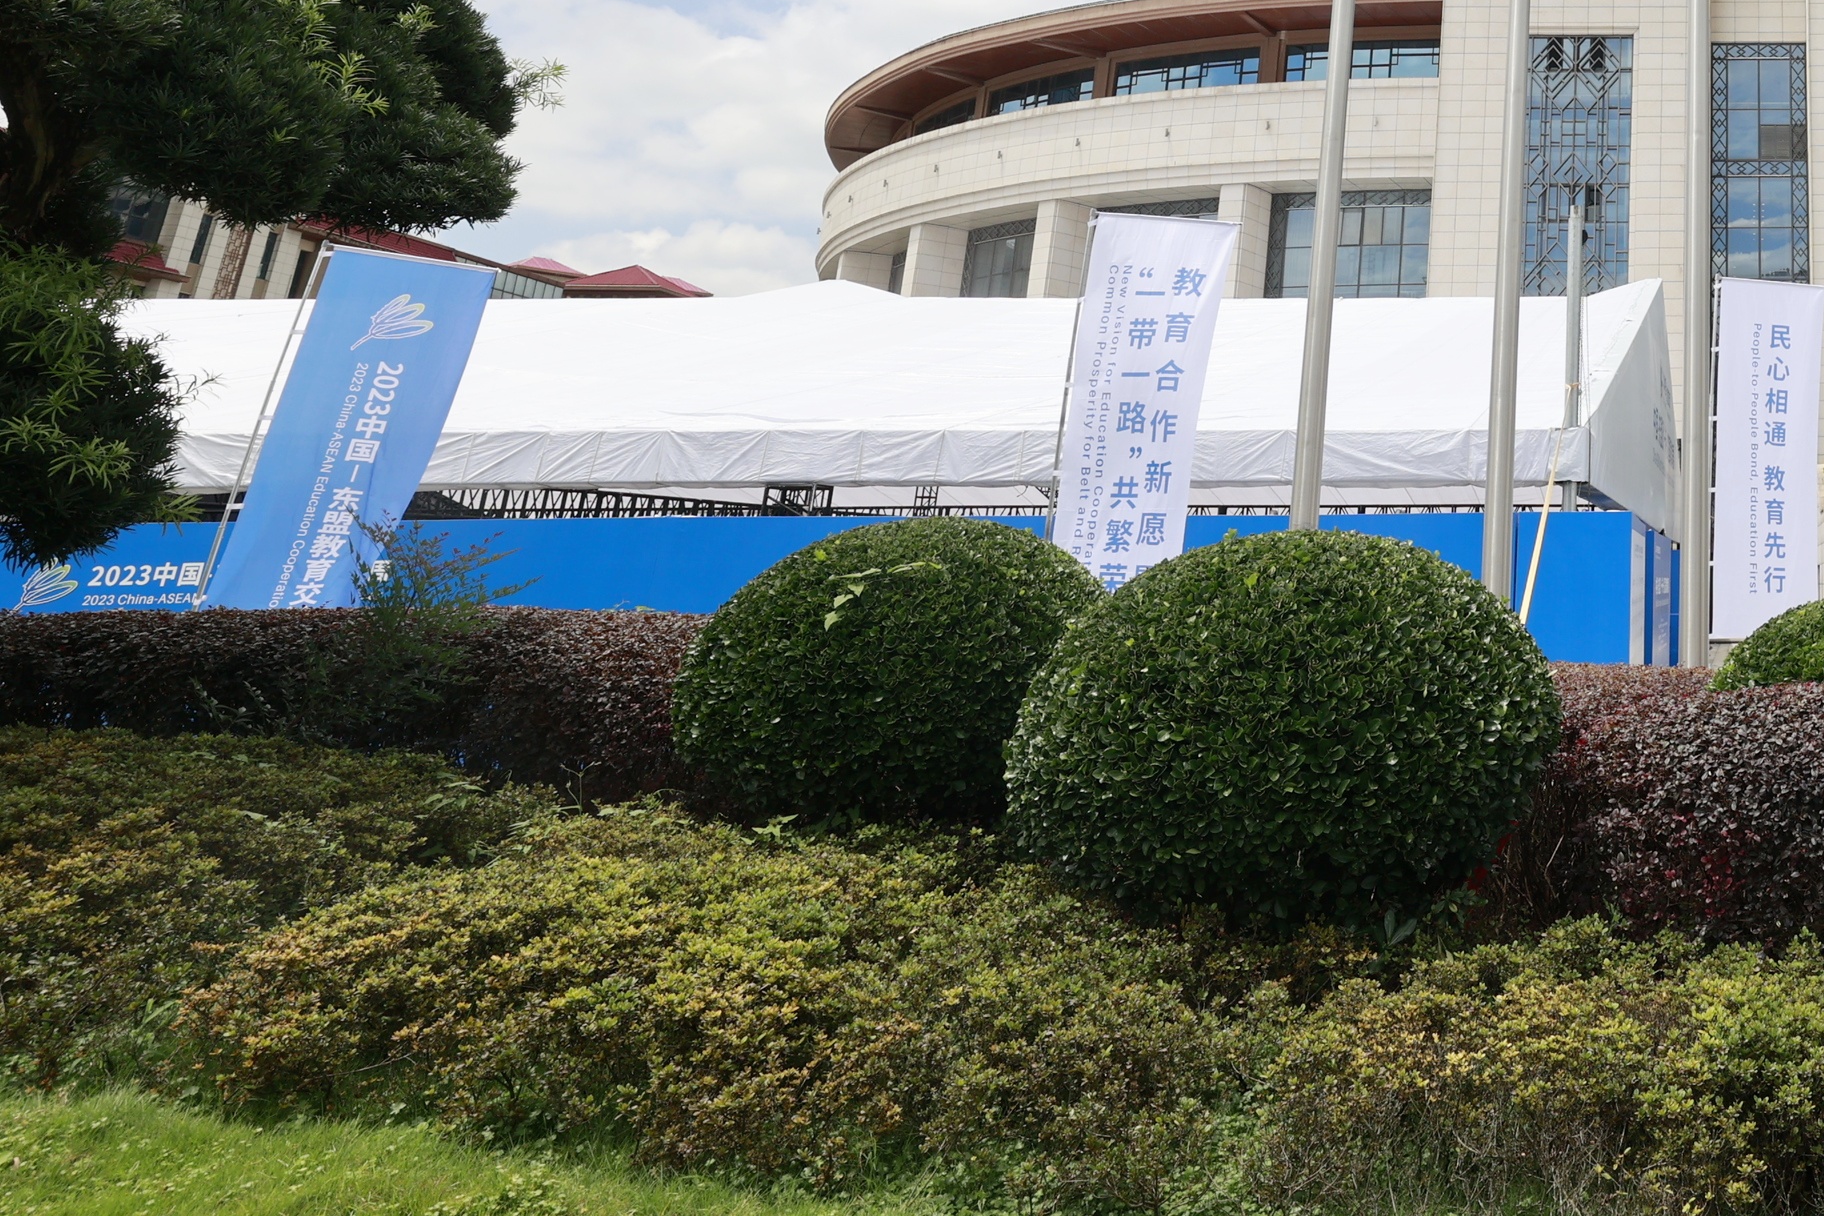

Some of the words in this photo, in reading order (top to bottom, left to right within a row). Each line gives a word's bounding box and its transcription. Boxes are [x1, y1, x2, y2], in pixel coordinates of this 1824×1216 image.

[1098, 264, 1119, 334] Common
[1119, 265, 1133, 298] New
[1109, 304, 1126, 355] Vision
[349, 362, 369, 393] 2023
[1083, 341, 1107, 430] Prosperity
[1103, 361, 1117, 385] for
[1748, 323, 1762, 438] People-to-People
[1763, 324, 1791, 447] 民心相通
[319, 394, 358, 474] China-ASEAN
[1082, 435, 1095, 460] for
[1095, 392, 1112, 478] Education
[1749, 443, 1759, 481] Bond,
[296, 476, 329, 537] Education
[1079, 467, 1092, 501] Belt
[1073, 507, 1086, 538] and
[1084, 486, 1104, 566] Cooperat
[1749, 487, 1759, 558] Education
[1763, 464, 1786, 594] 教育先行
[82, 594, 115, 606] 2023
[87, 561, 212, 587] 2023中国
[268, 539, 306, 610] Cooperatio
[1749, 562, 1759, 595] First
